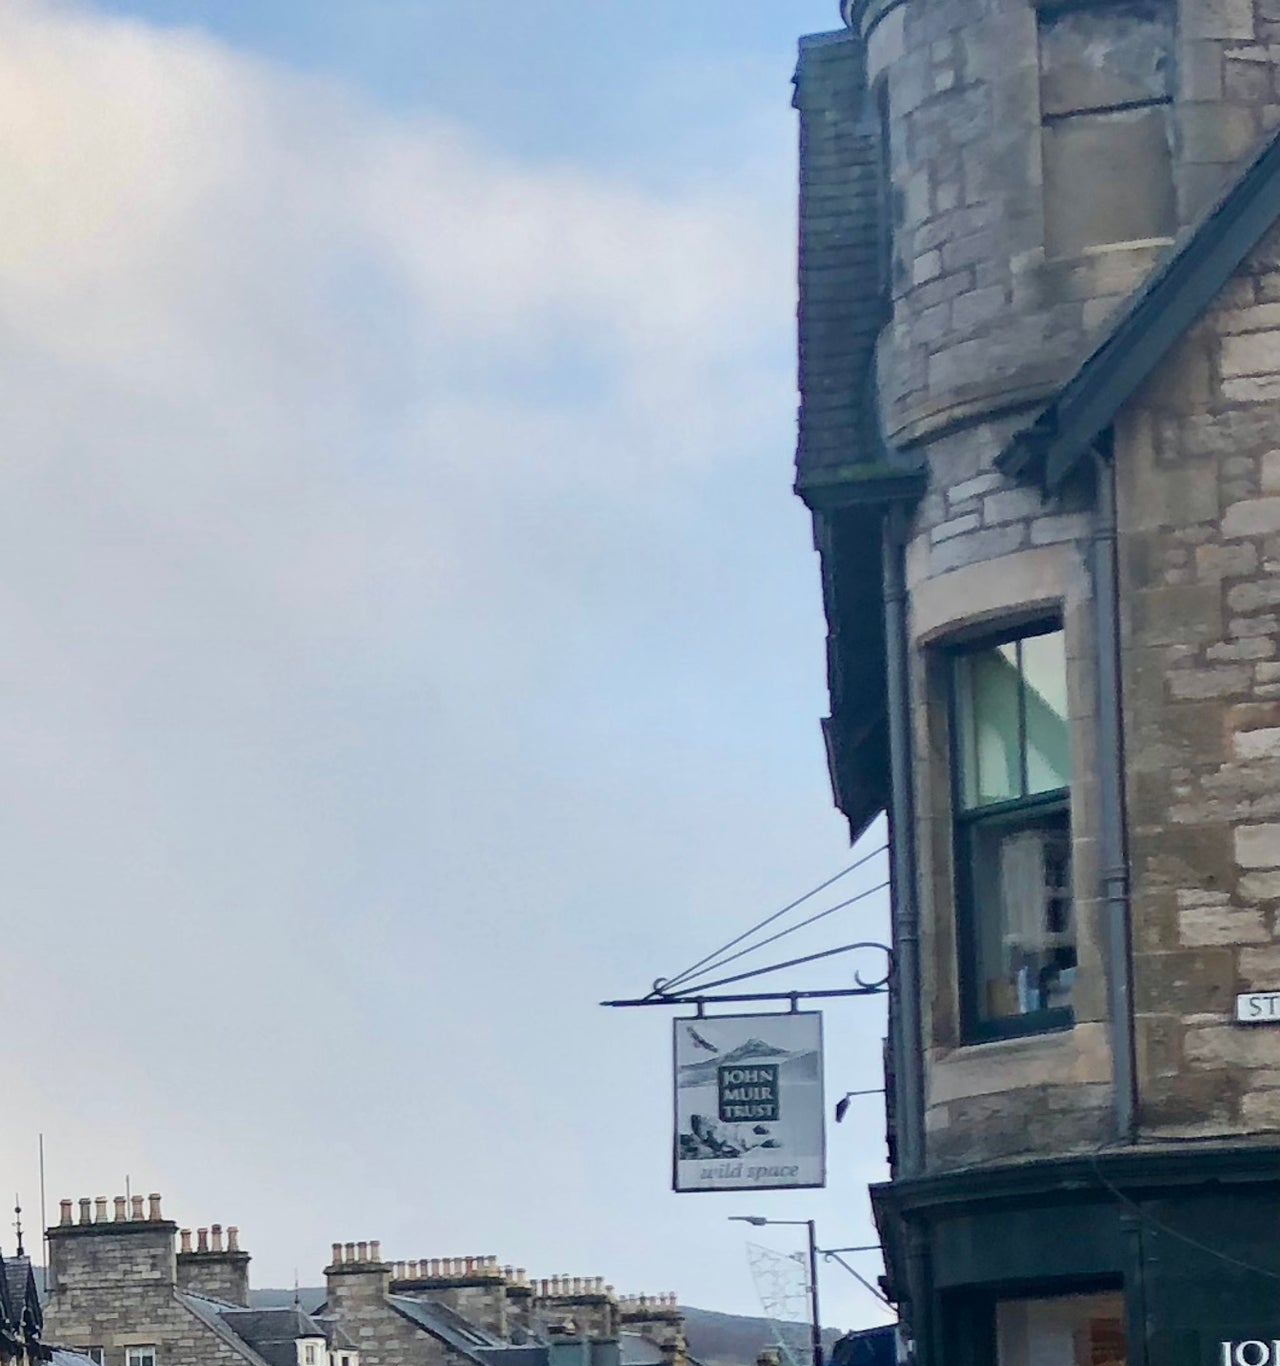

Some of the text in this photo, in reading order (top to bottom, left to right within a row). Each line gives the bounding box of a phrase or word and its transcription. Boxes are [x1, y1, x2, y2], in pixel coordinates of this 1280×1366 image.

[722, 1069, 774, 1086] JOHN
[723, 1087, 774, 1101] MUIR
[723, 1104, 775, 1118] TRUST
[700, 1162, 799, 1182] wild space
